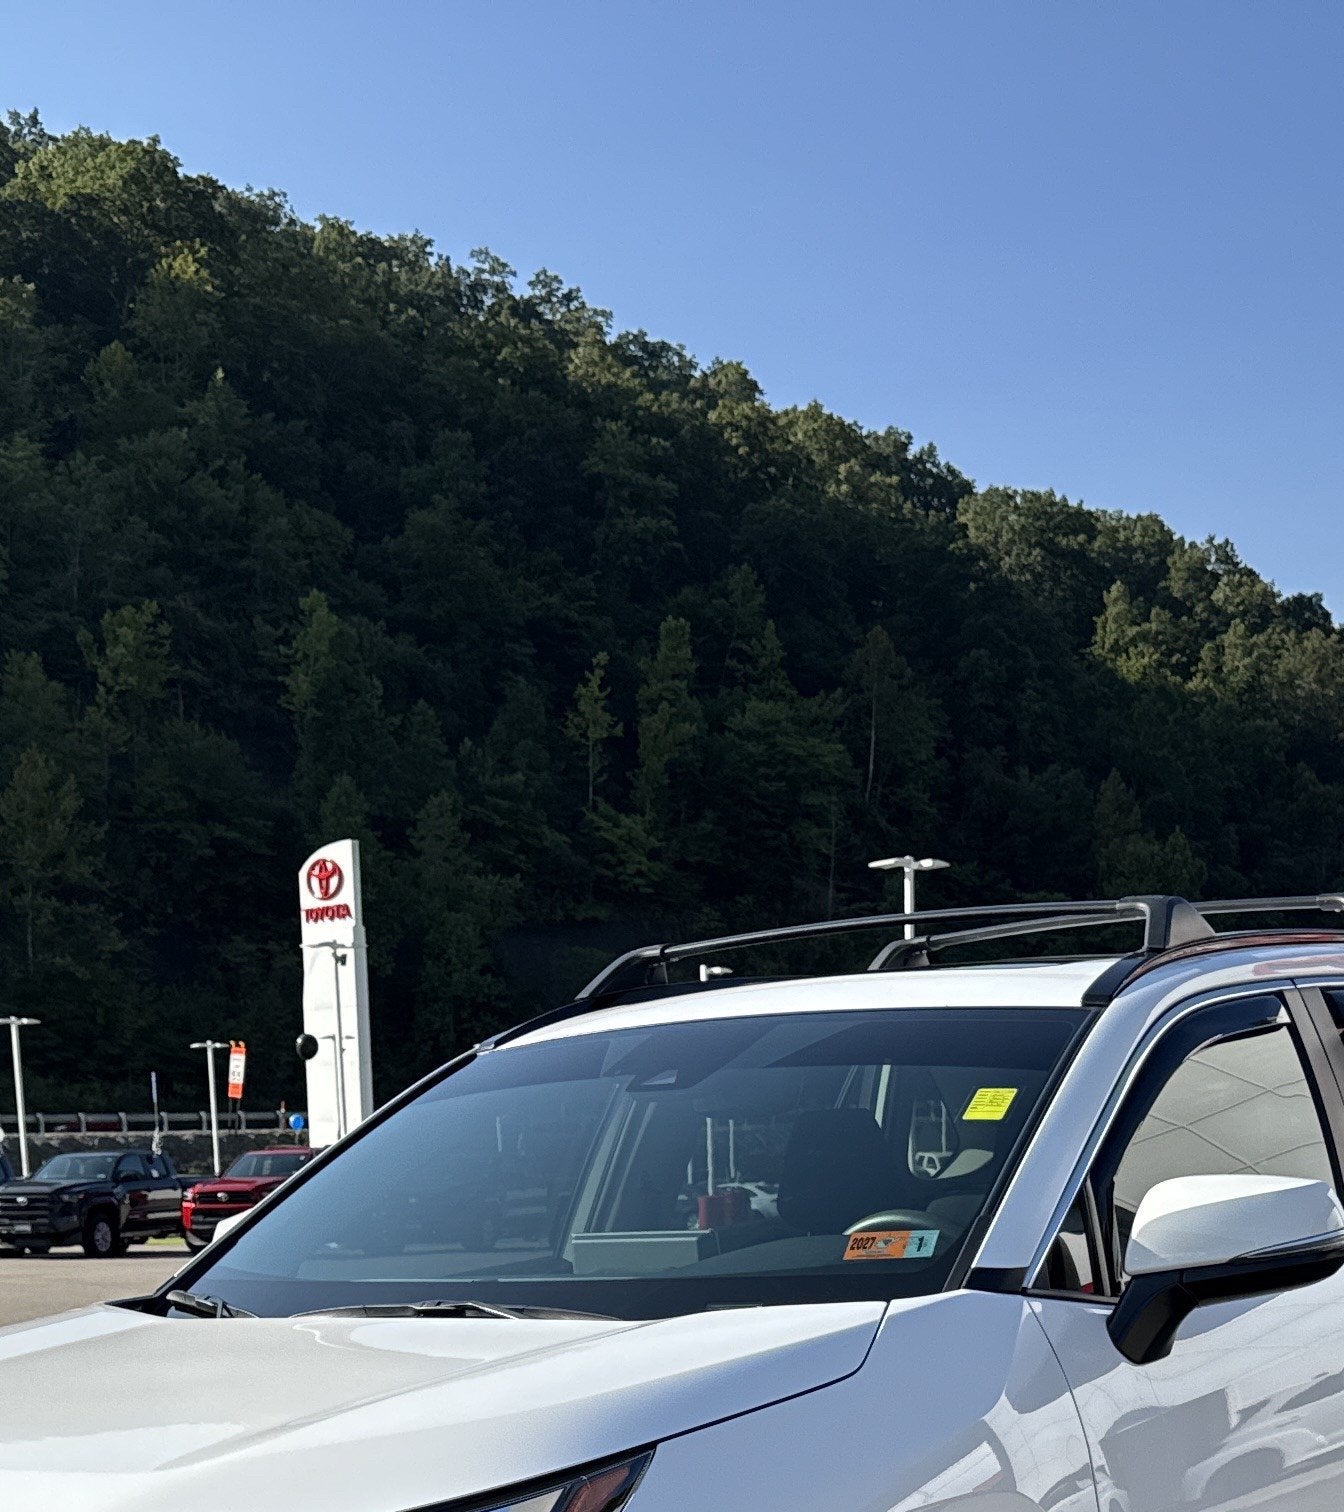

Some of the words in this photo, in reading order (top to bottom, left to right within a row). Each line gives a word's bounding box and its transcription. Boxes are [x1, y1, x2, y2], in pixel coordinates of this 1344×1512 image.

[304, 903, 353, 924] TOYOTA
[849, 1236, 877, 1251] 2027
[916, 1235, 925, 1252] 1
